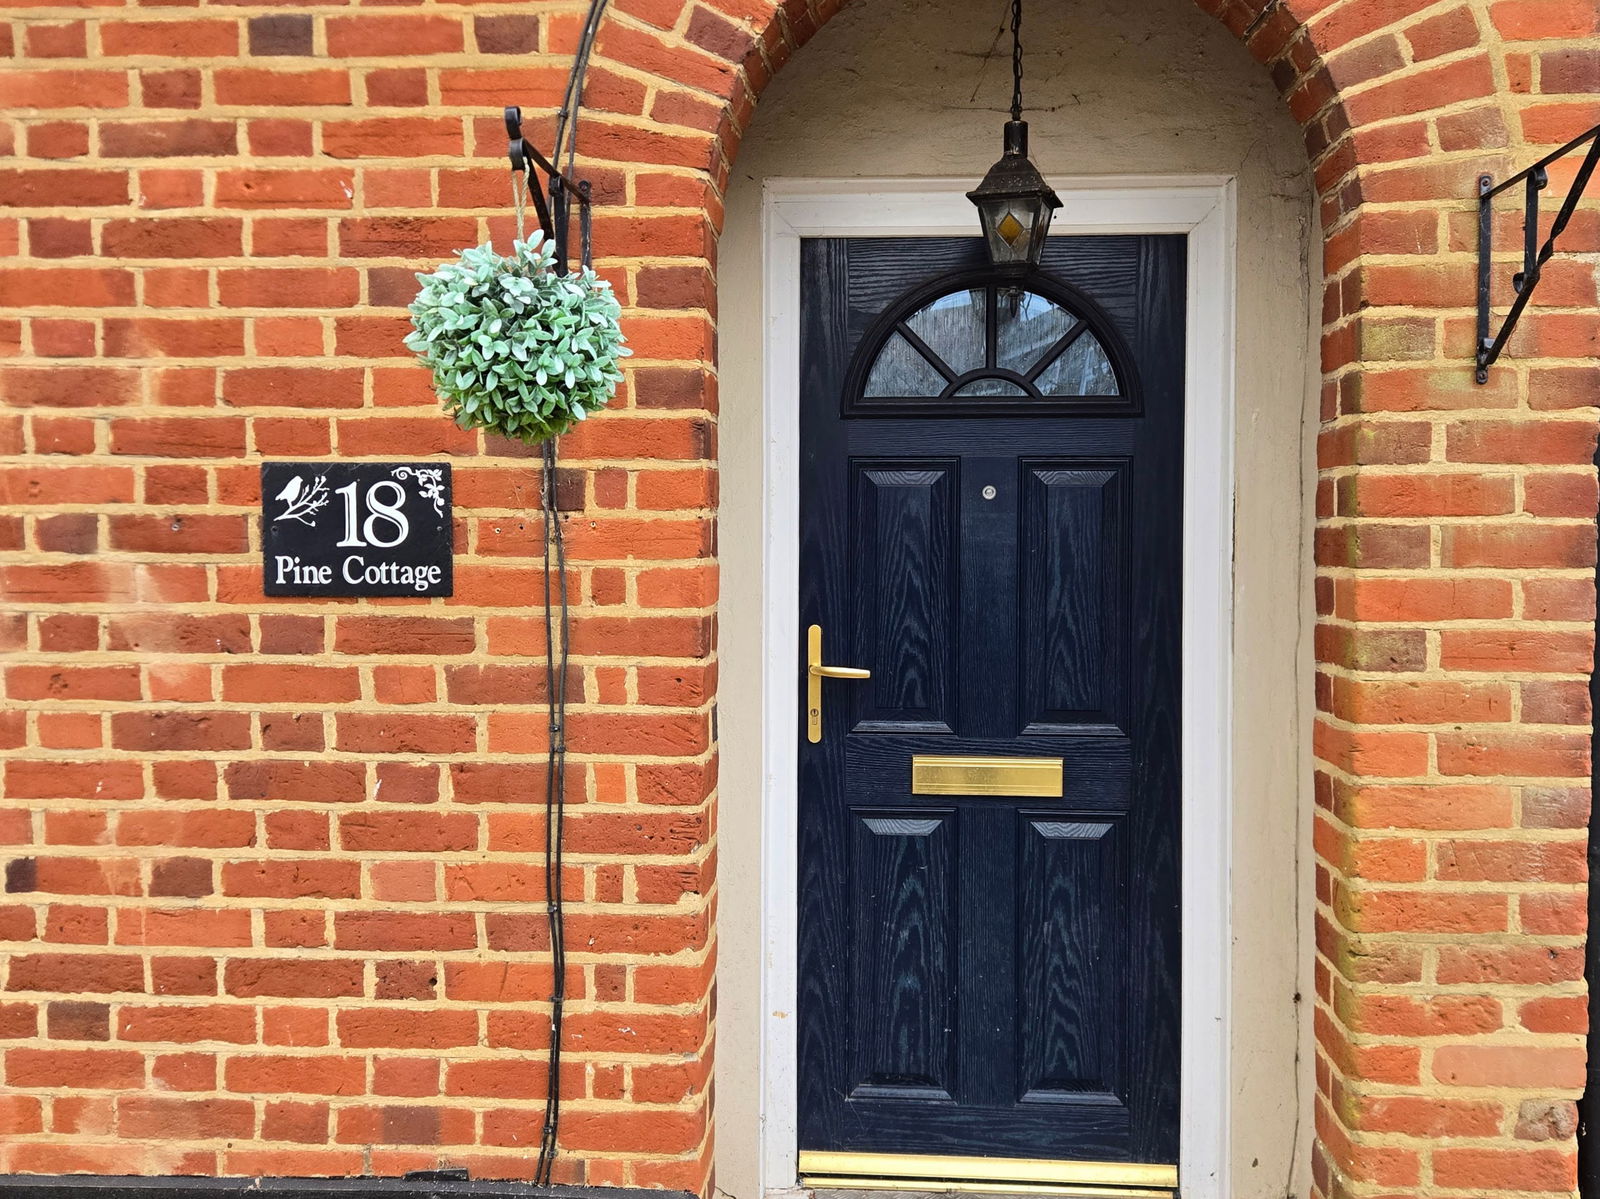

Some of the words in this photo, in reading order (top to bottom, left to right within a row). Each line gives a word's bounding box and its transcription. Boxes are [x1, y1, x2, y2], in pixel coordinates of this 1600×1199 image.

[335, 480, 410, 548] 18
[274, 555, 333, 585] Pine
[342, 555, 442, 592] Cottage
